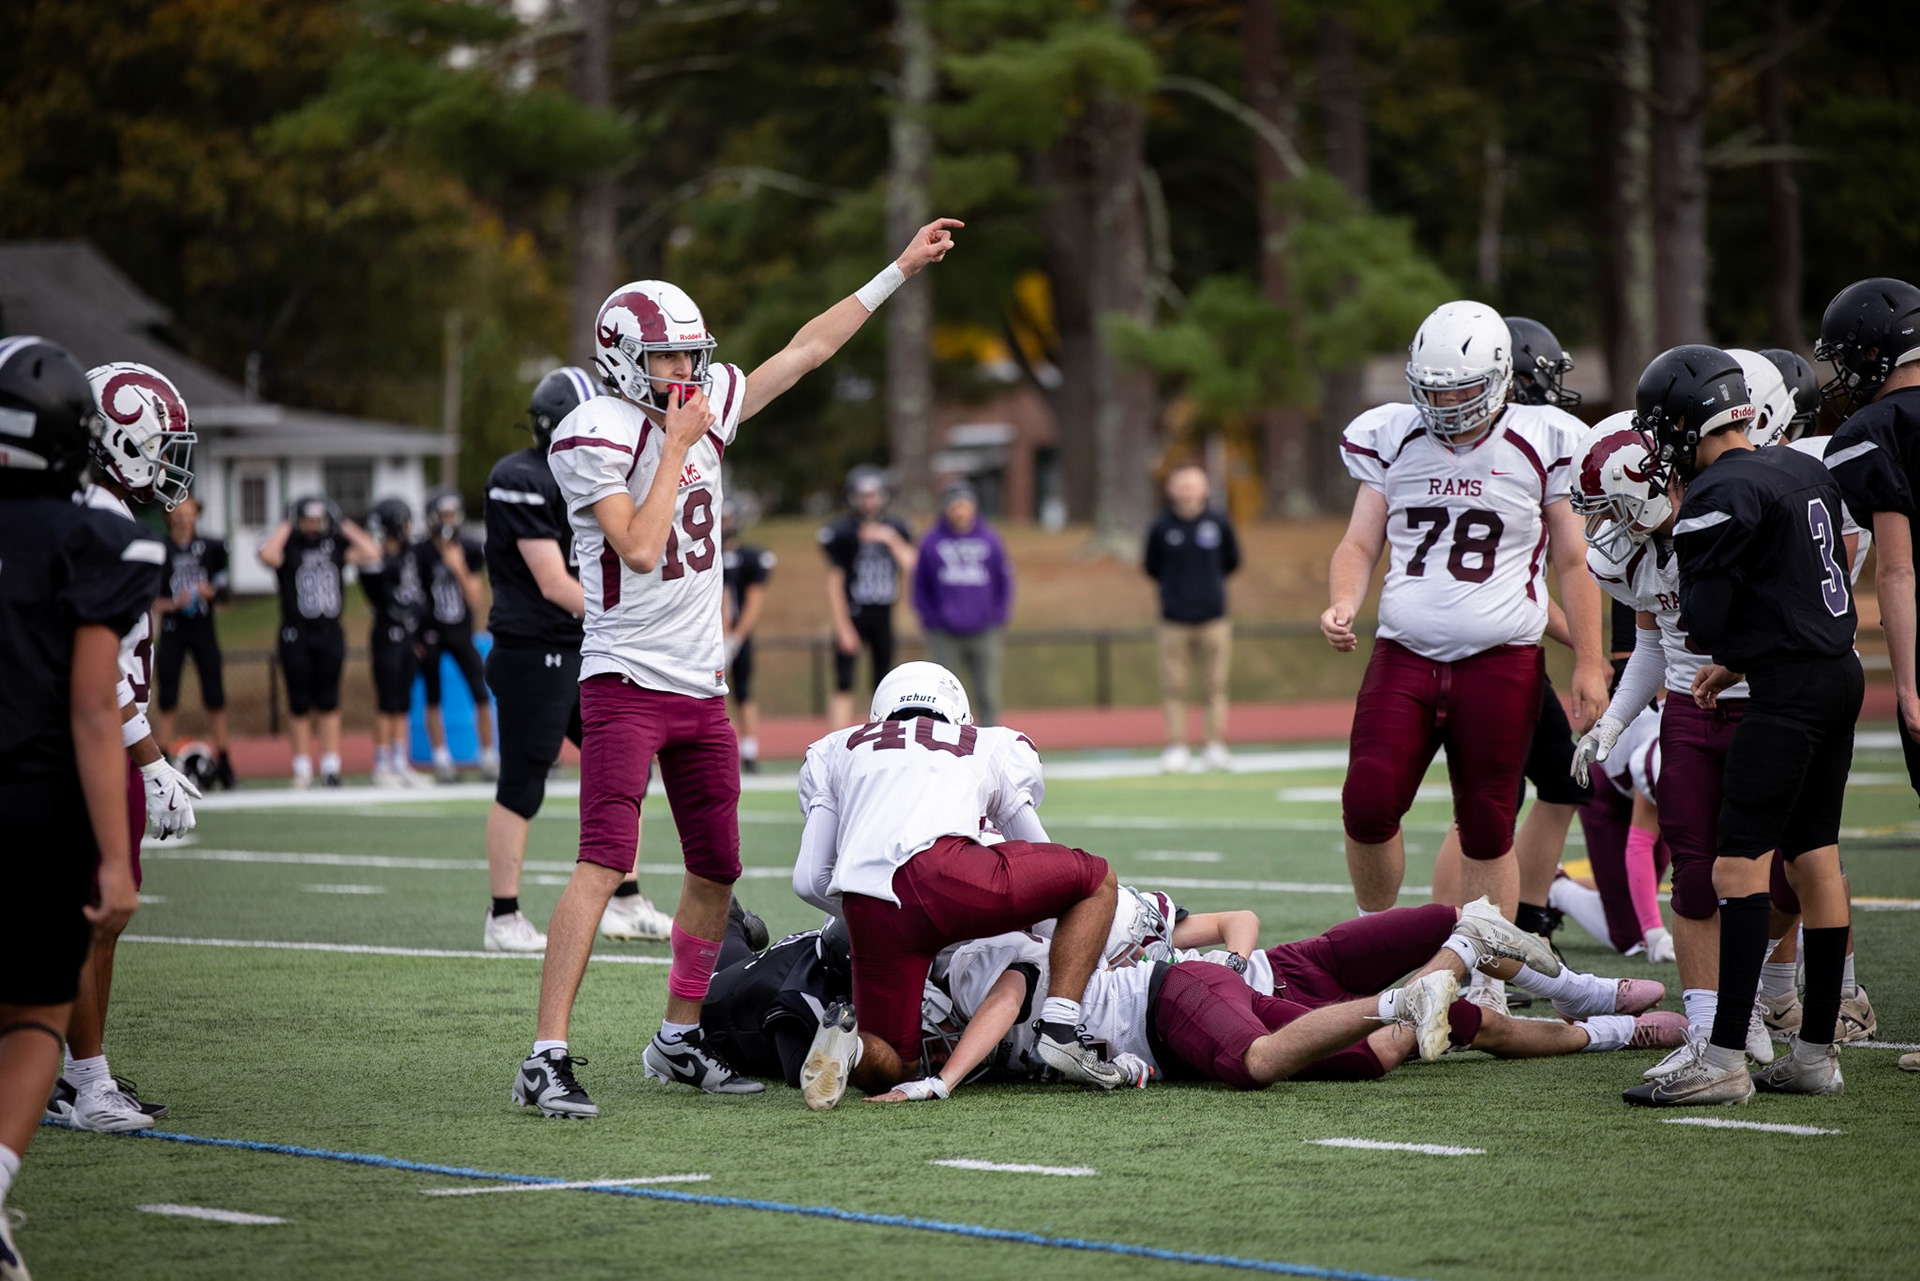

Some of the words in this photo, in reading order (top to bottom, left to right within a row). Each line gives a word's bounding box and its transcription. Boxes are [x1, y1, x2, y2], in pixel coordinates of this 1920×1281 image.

[1428, 477, 1482, 497] RAMS
[661, 487, 715, 581] 19
[1406, 506, 1504, 584] 78
[1808, 498, 1849, 617] 3
[899, 692, 937, 704] schutt
[846, 715, 978, 758] 40
